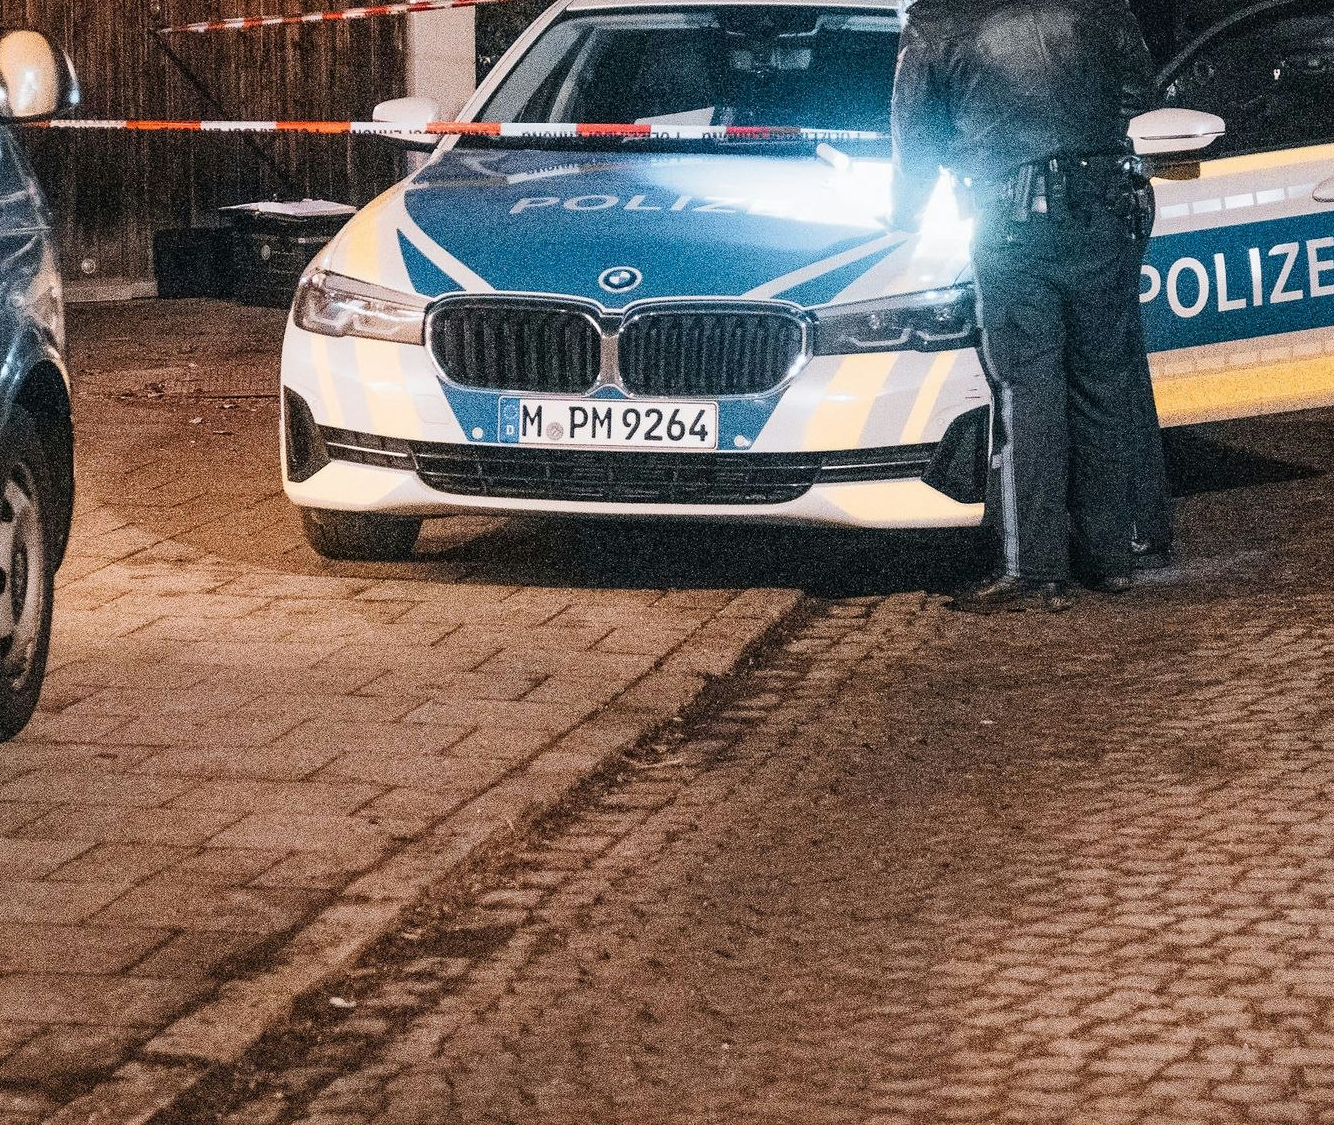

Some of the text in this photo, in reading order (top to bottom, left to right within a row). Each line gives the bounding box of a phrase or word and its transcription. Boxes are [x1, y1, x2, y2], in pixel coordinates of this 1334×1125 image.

[521, 404, 543, 437] M
[568, 406, 612, 440] PM
[622, 408, 709, 442] 9264
